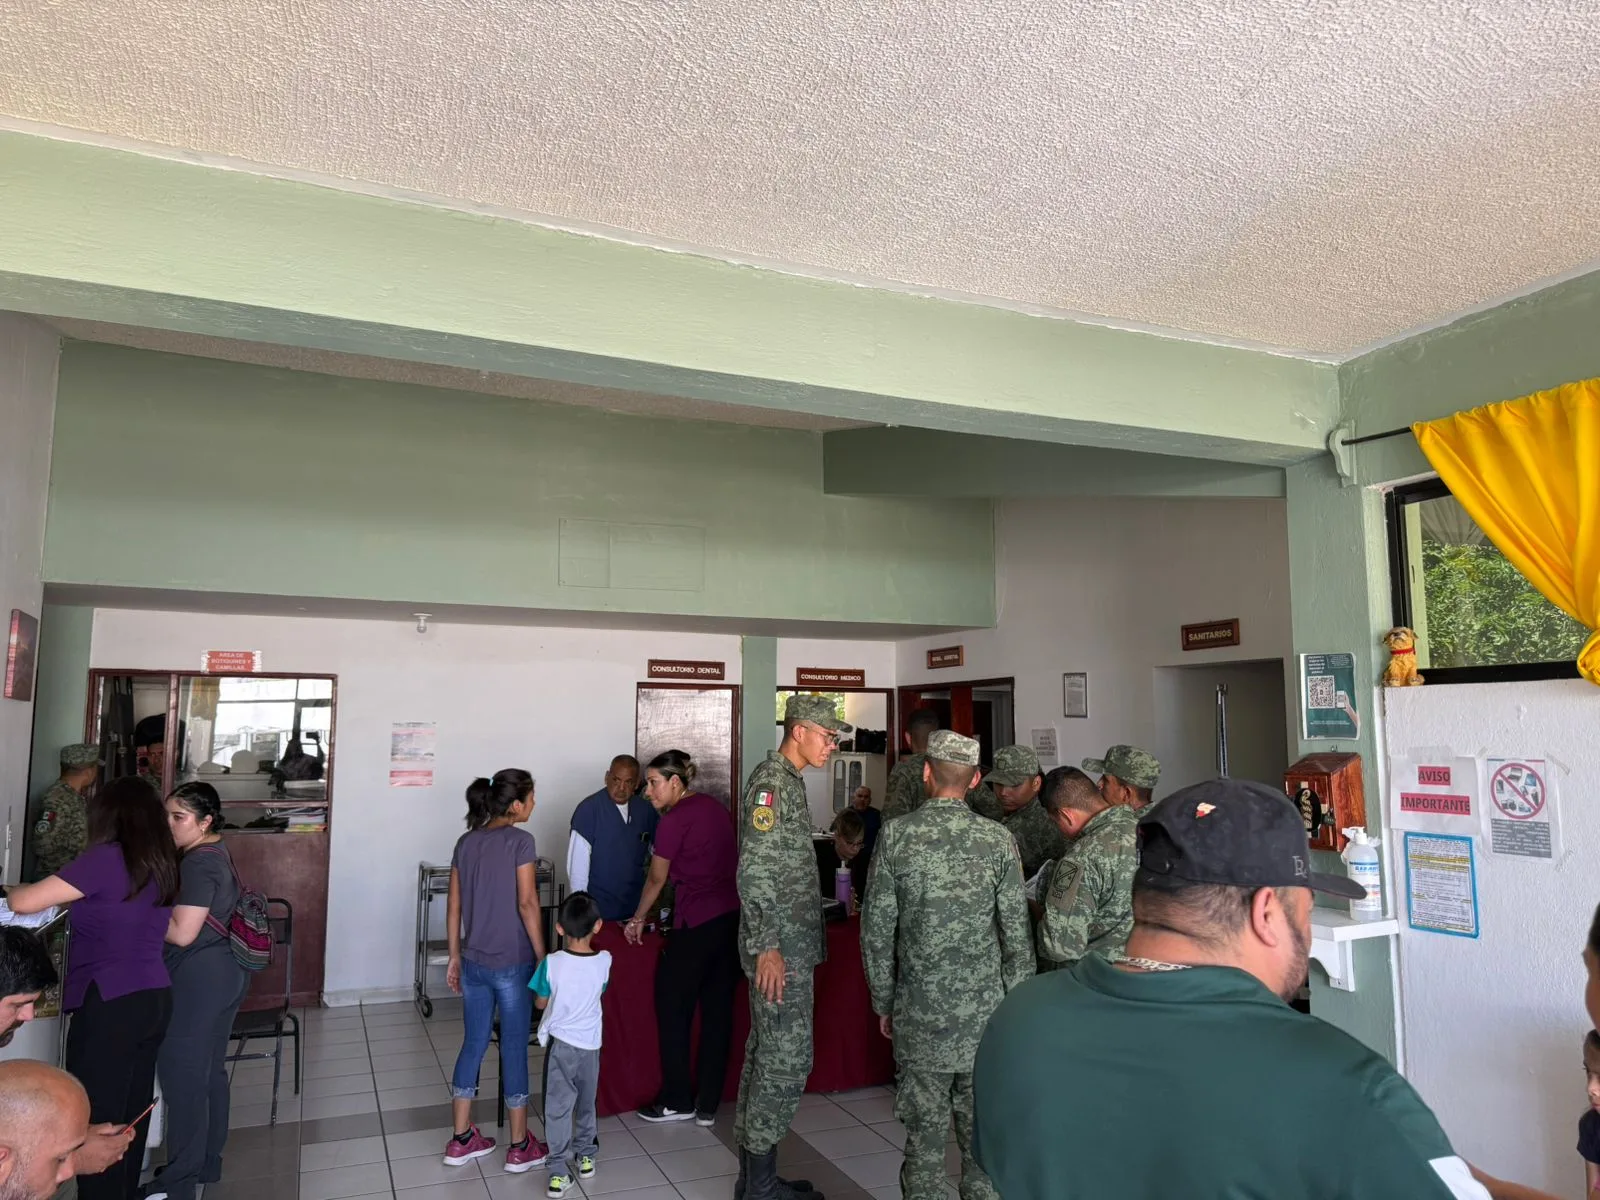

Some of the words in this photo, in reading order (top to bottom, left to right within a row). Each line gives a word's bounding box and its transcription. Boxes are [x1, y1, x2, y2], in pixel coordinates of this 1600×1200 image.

[1188, 629, 1233, 641] SANITARIOS
[651, 665, 695, 673] CONSULTORIO
[800, 673, 838, 681] CONSULTORIO
[1418, 770, 1451, 782] AVISO
[1400, 796, 1471, 812] IMPORTANTE
